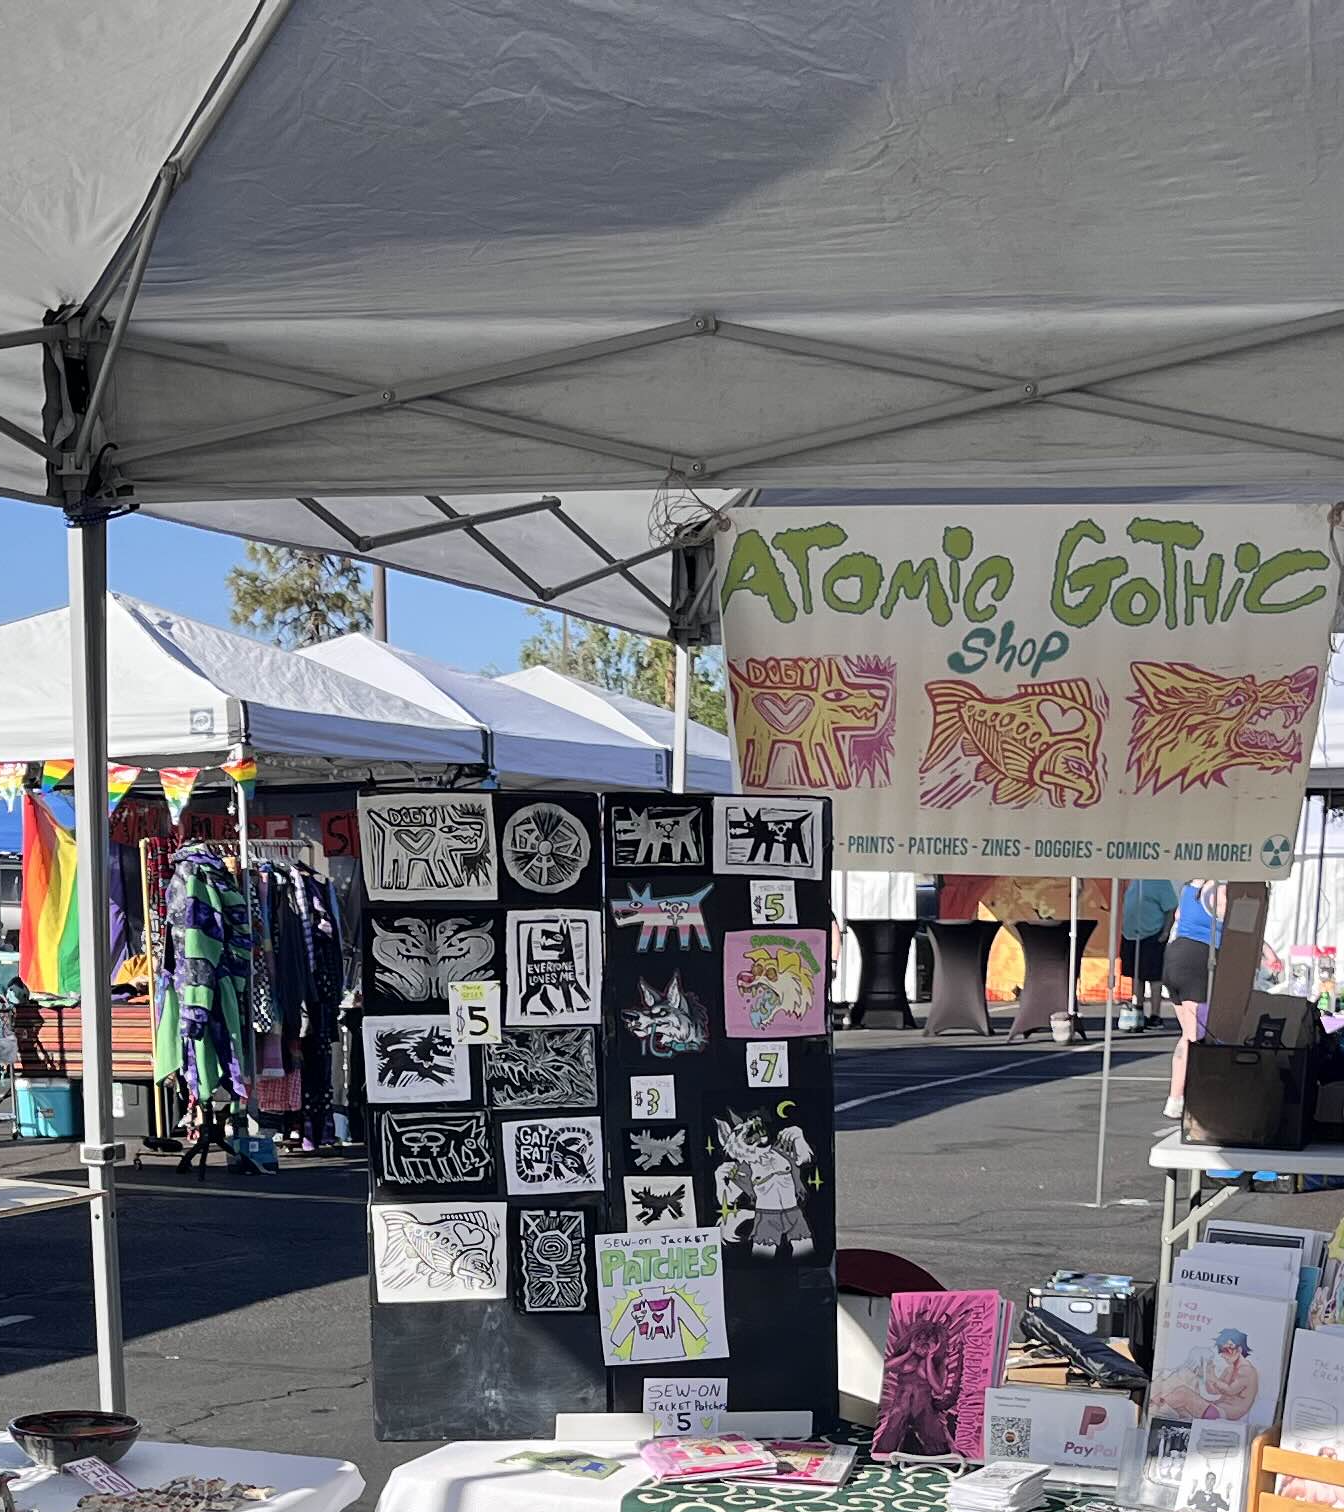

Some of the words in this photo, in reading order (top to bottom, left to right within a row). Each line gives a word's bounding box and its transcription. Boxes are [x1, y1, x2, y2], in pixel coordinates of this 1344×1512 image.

[847, 835, 896, 856] PRINTS
[908, 837, 969, 857] PATCHES
[980, 838, 1022, 858] ZINES
[1033, 839, 1094, 860] DOGGIES
[1105, 840, 1161, 861] COMICS
[1173, 842, 1205, 862] AND
[1207, 843, 1253, 863] MORE!
[526, 960, 575, 974] EVERYONE
[528, 973, 558, 986] LOVES
[559, 971, 576, 983] ME
[519, 1124, 552, 1145] GAY
[519, 1146, 552, 1162] RAT
[1180, 1268, 1241, 1287] DEADLIEST
[970, 1303, 987, 1328] THE
[648, 1384, 721, 1399] SEW-ON
[1064, 1441, 1119, 1458] PayPal
